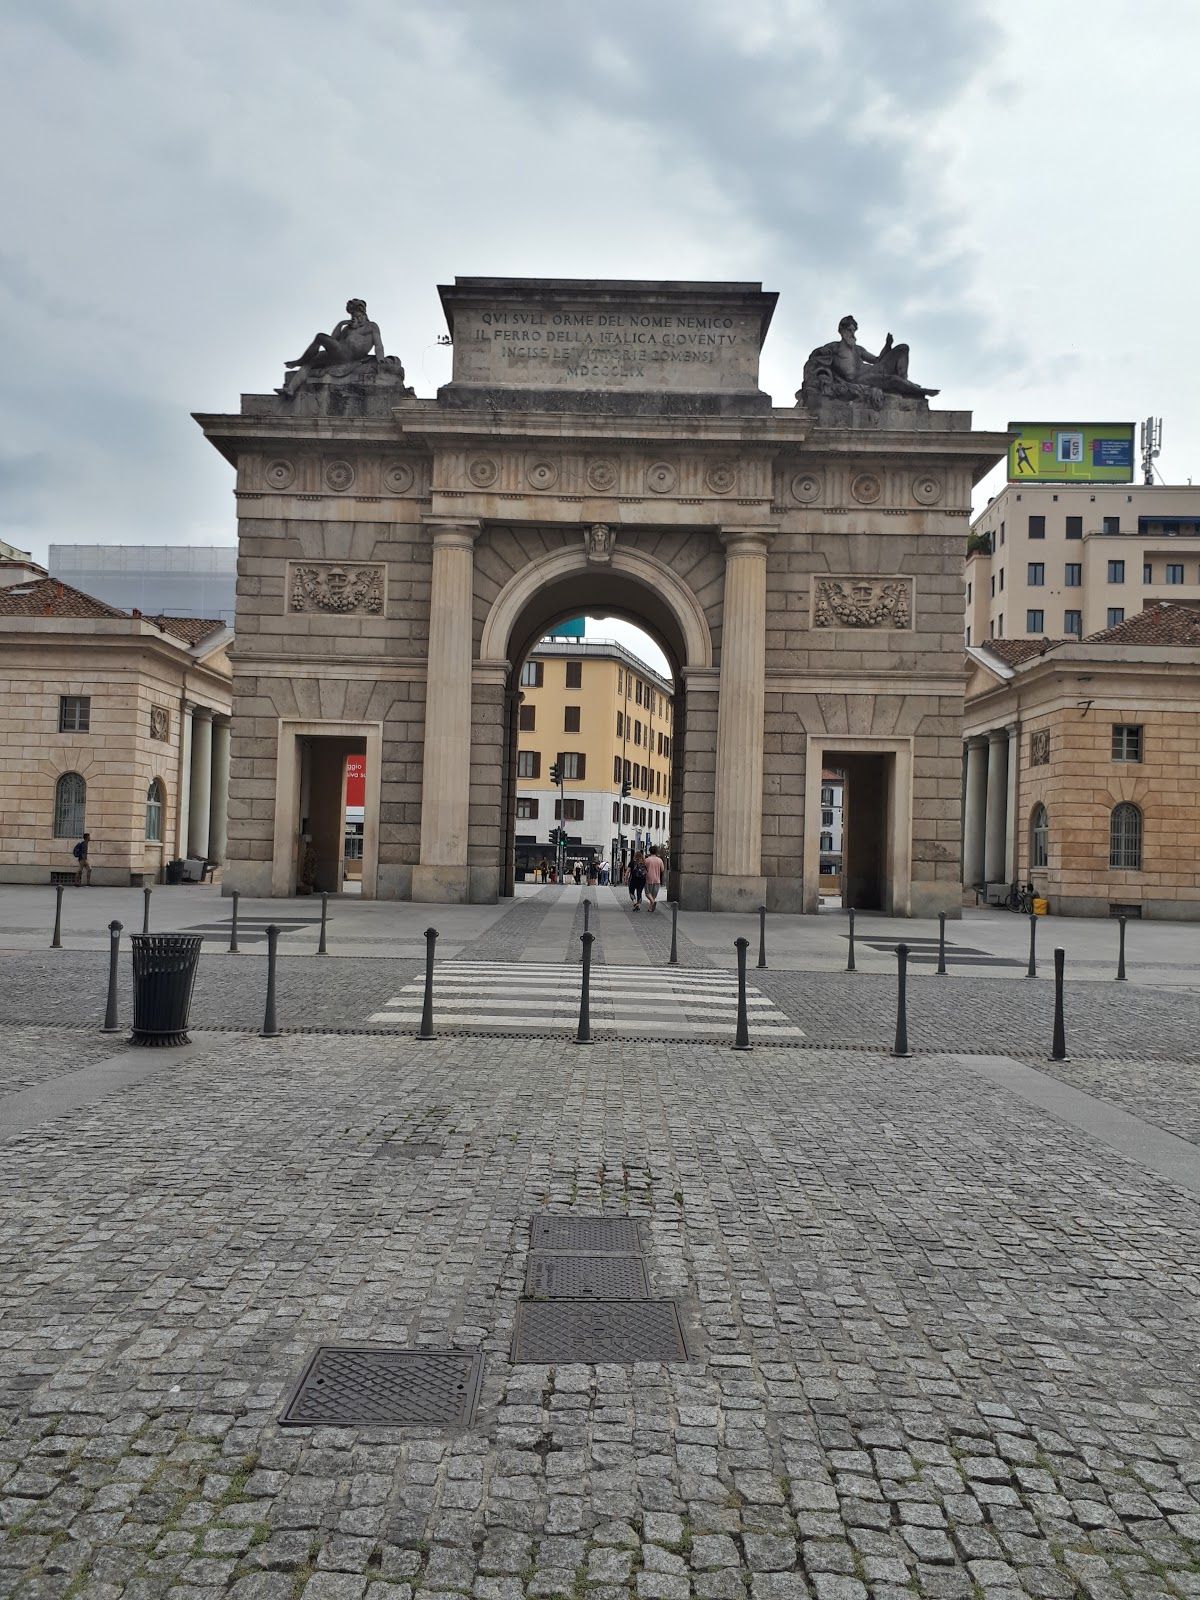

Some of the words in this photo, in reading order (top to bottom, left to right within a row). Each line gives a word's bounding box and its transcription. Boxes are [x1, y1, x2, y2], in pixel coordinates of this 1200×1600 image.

[482, 313, 507, 326] QVI
[512, 313, 547, 325] SVLL
[552, 314, 593, 326] ORME
[598, 315, 624, 327] DEL
[630, 316, 672, 328] NOME
[677, 317, 733, 329] NEMICO
[475, 329, 490, 341] IL
[494, 330, 542, 341] FERRO
[546, 331, 593, 343] DELLA
[599, 332, 657, 344] ITALICA
[662, 333, 737, 346] GIOVENTV
[501, 346, 548, 359] INCISE
[553, 347, 570, 359] LE
